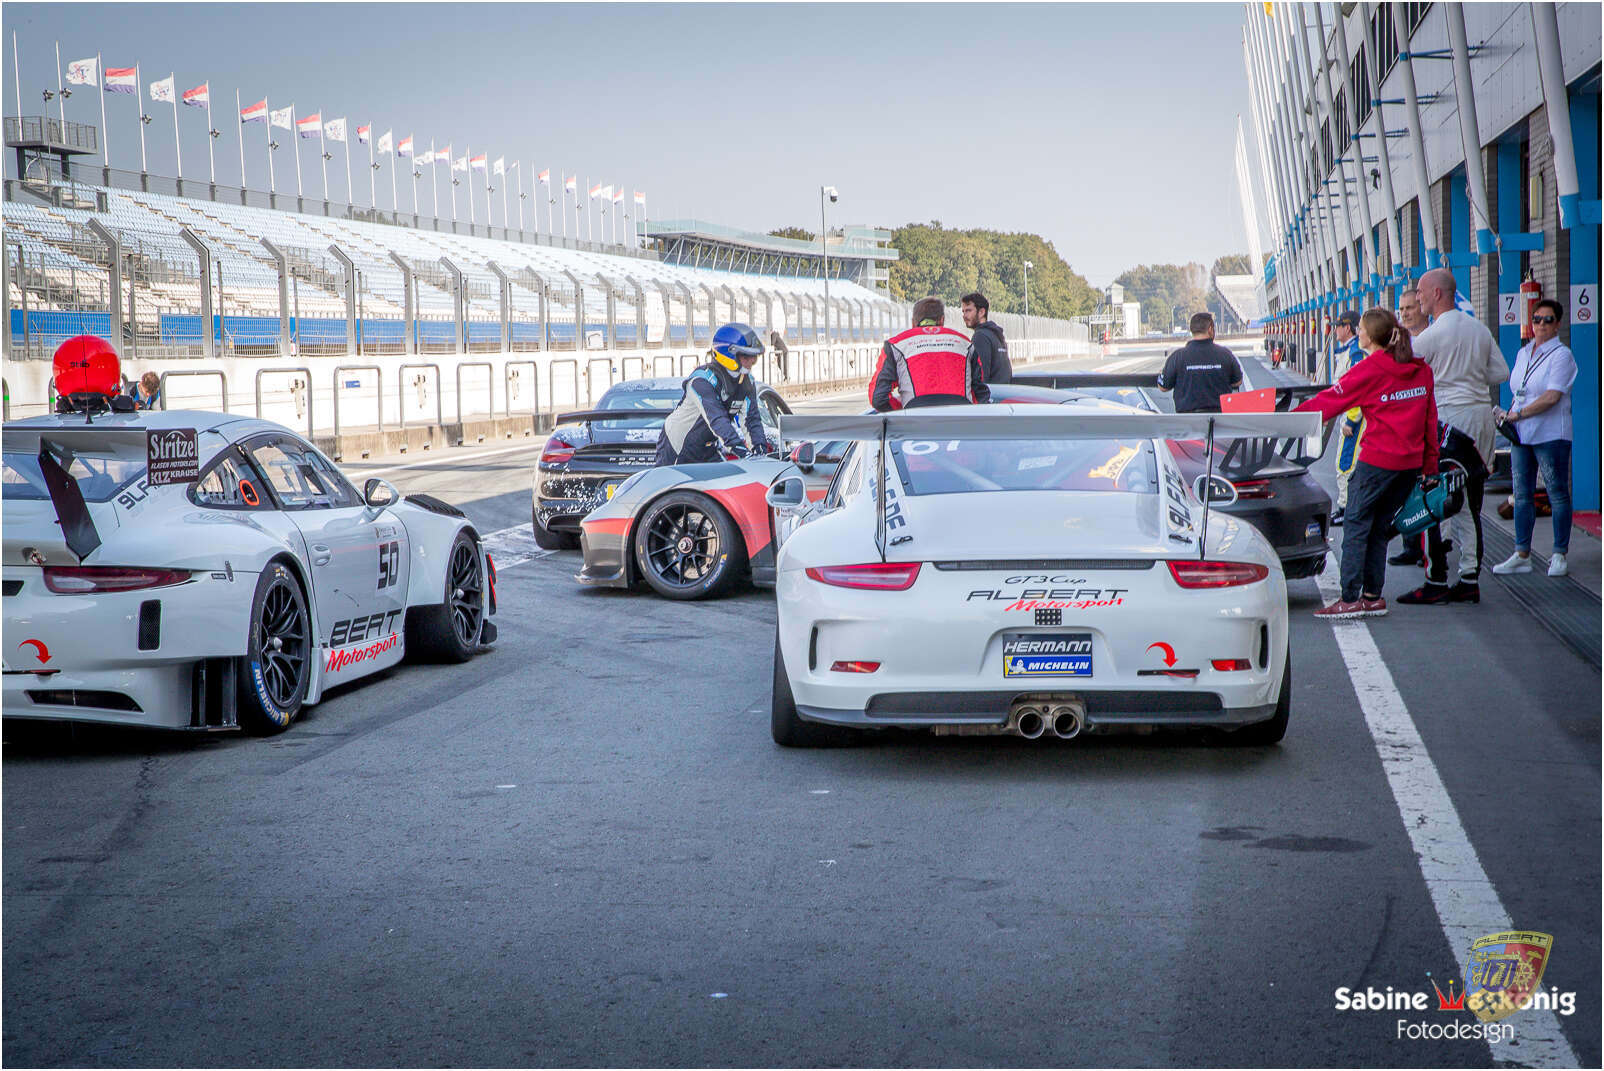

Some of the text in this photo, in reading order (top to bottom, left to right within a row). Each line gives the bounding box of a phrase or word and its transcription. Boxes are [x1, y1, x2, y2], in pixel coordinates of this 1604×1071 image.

[1505, 296, 1515, 311] 7
[1579, 288, 1590, 306] 6
[150, 433, 198, 460] Stritzel
[170, 468, 198, 479] KRAUSE
[1004, 575, 1087, 585] GT3 Cup
[966, 589, 1129, 602] ALBERT
[1004, 597, 1124, 612] Motorsport
[325, 631, 398, 673] Motorsport
[1003, 640, 1092, 654] HERMANN
[1028, 661, 1089, 671] MICHELIN
[254, 668, 281, 723] MICHELIN
